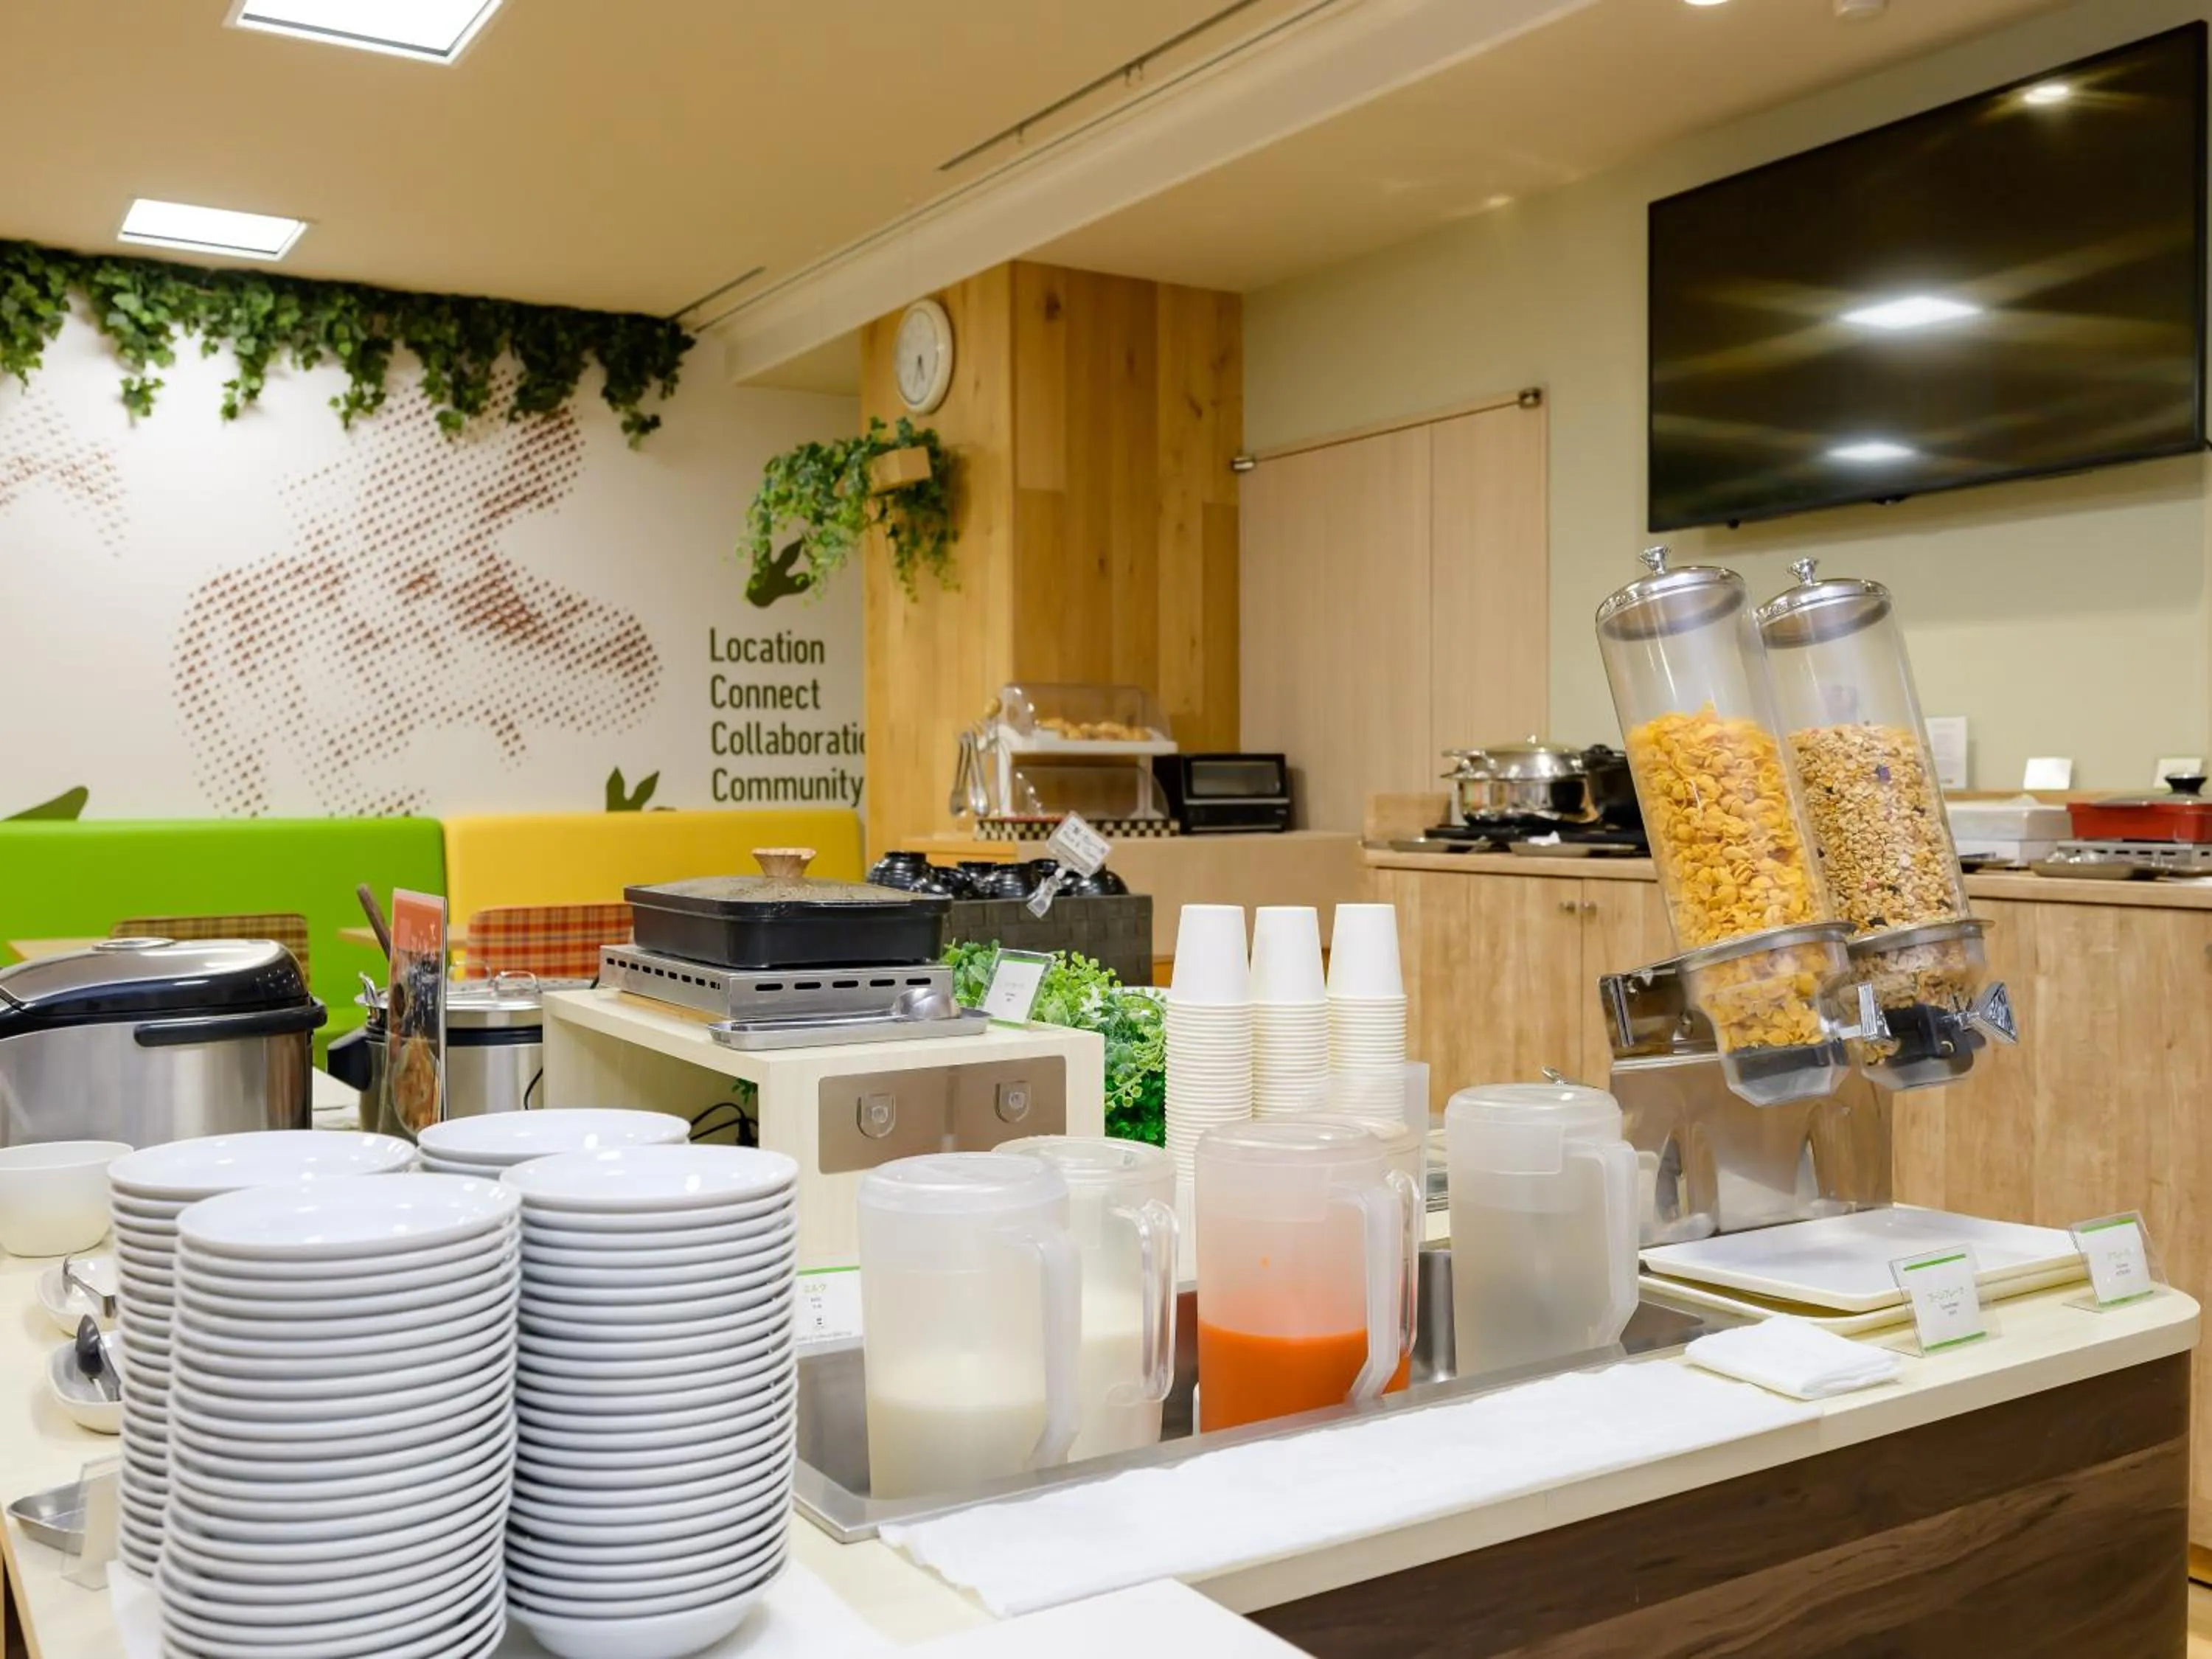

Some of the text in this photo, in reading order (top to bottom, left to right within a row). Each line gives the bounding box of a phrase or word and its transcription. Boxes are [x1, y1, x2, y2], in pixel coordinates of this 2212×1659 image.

[709, 627, 825, 664] Location
[710, 674, 821, 709] Connect
[712, 768, 864, 808] Community
